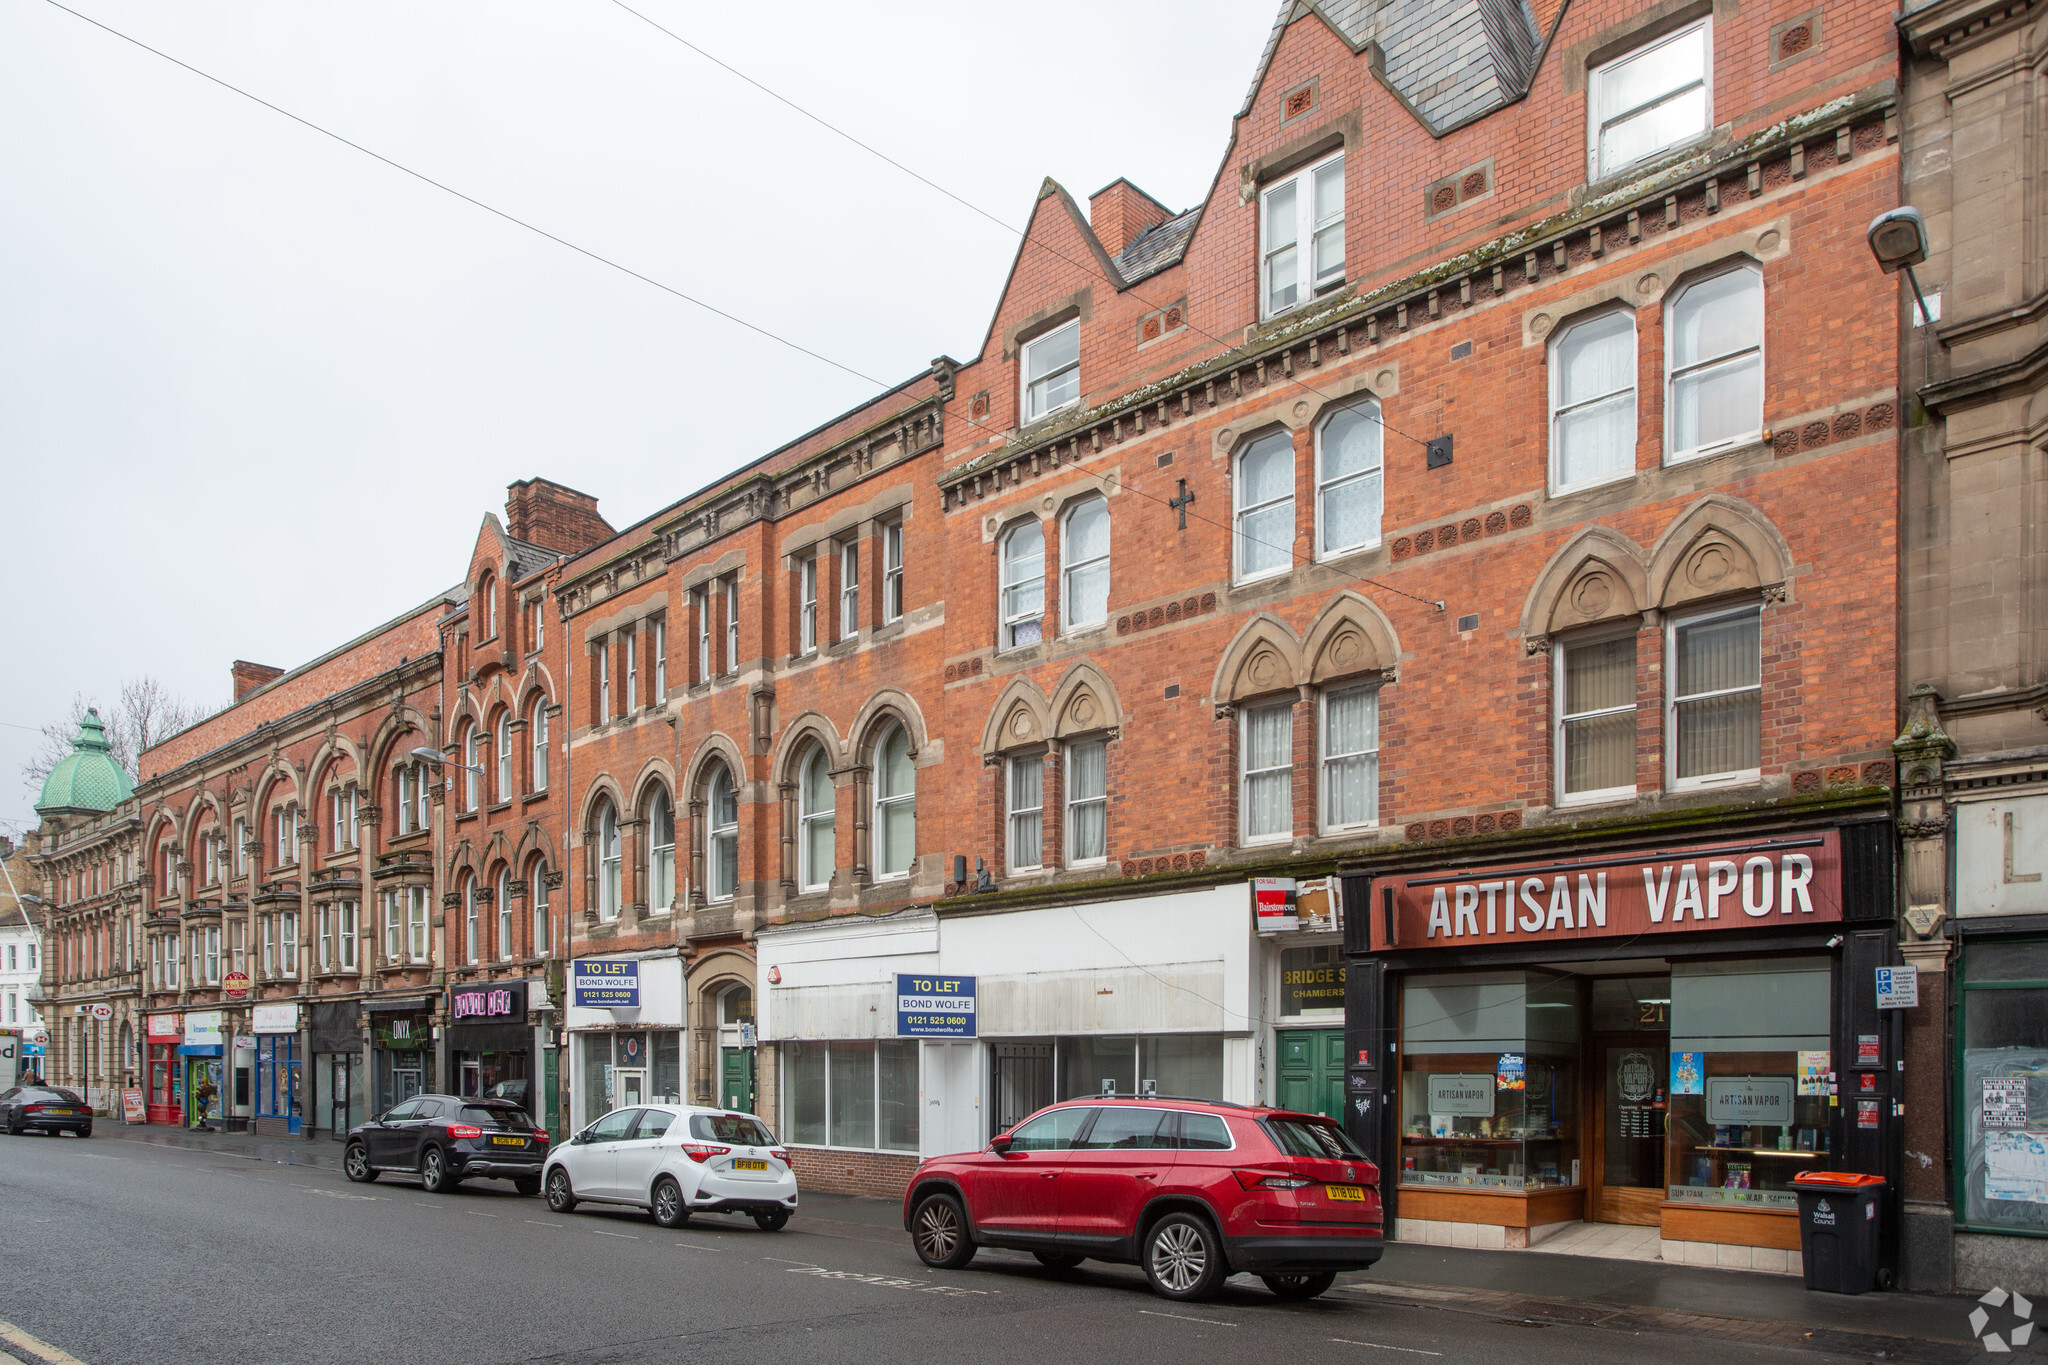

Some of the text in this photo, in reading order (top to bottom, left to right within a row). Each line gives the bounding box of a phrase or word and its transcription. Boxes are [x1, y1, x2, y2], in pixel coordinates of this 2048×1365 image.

[1427, 854, 1814, 938] ARTISAN VAPOR
[584, 963, 628, 974] TO LET
[1284, 968, 1334, 985] BRIDGE
[913, 980, 960, 992] TO LET
[1293, 988, 1345, 998] CHAMBERS
[454, 990, 511, 1018] VIVID INK
[903, 1000, 970, 1009] BOND WOLFE
[1640, 1002, 1664, 1022] 21
[907, 1016, 966, 1025] 0121 525 0600
[393, 1020, 410, 1039] ONYX
[1624, 1073, 1647, 1085] VAPOR
[1438, 1090, 1484, 1100] ARTISAN VAPOR
[1719, 1095, 1780, 1106] ARTISAN VAPOR
[1331, 1187, 1347, 1198] DT18
[1671, 1189, 1684, 1197] SUN
[1686, 1190, 1703, 1198] 12AM
[1813, 1211, 1835, 1219] Walsall
